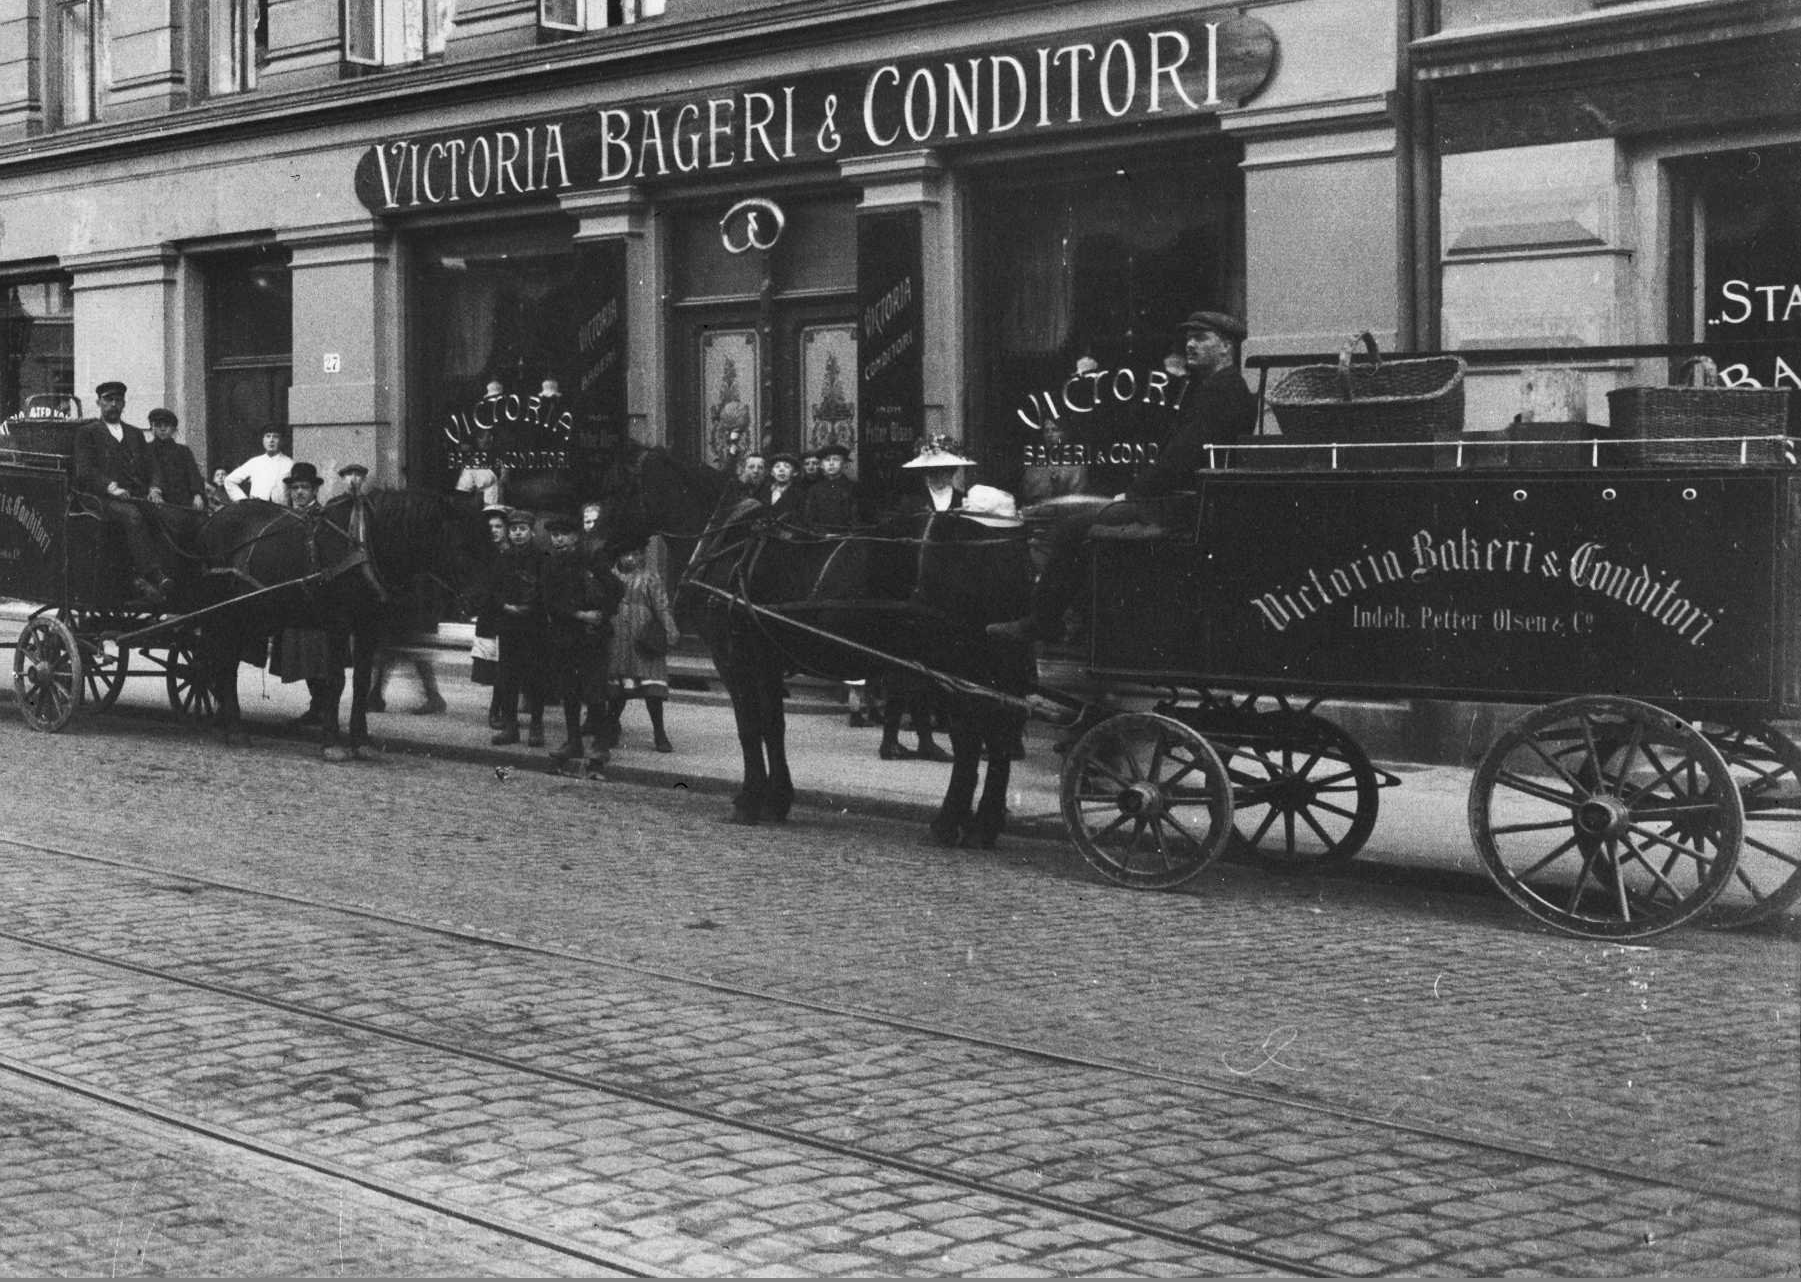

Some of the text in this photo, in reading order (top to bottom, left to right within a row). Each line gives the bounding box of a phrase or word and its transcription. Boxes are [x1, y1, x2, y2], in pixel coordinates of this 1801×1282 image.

[375, 22, 1221, 209] VICTORIA BAGERI & CONDITORI
[1250, 527, 1725, 646] Victoria Bakeri & Conditori
[1493, 608, 1547, 632] Olsen
